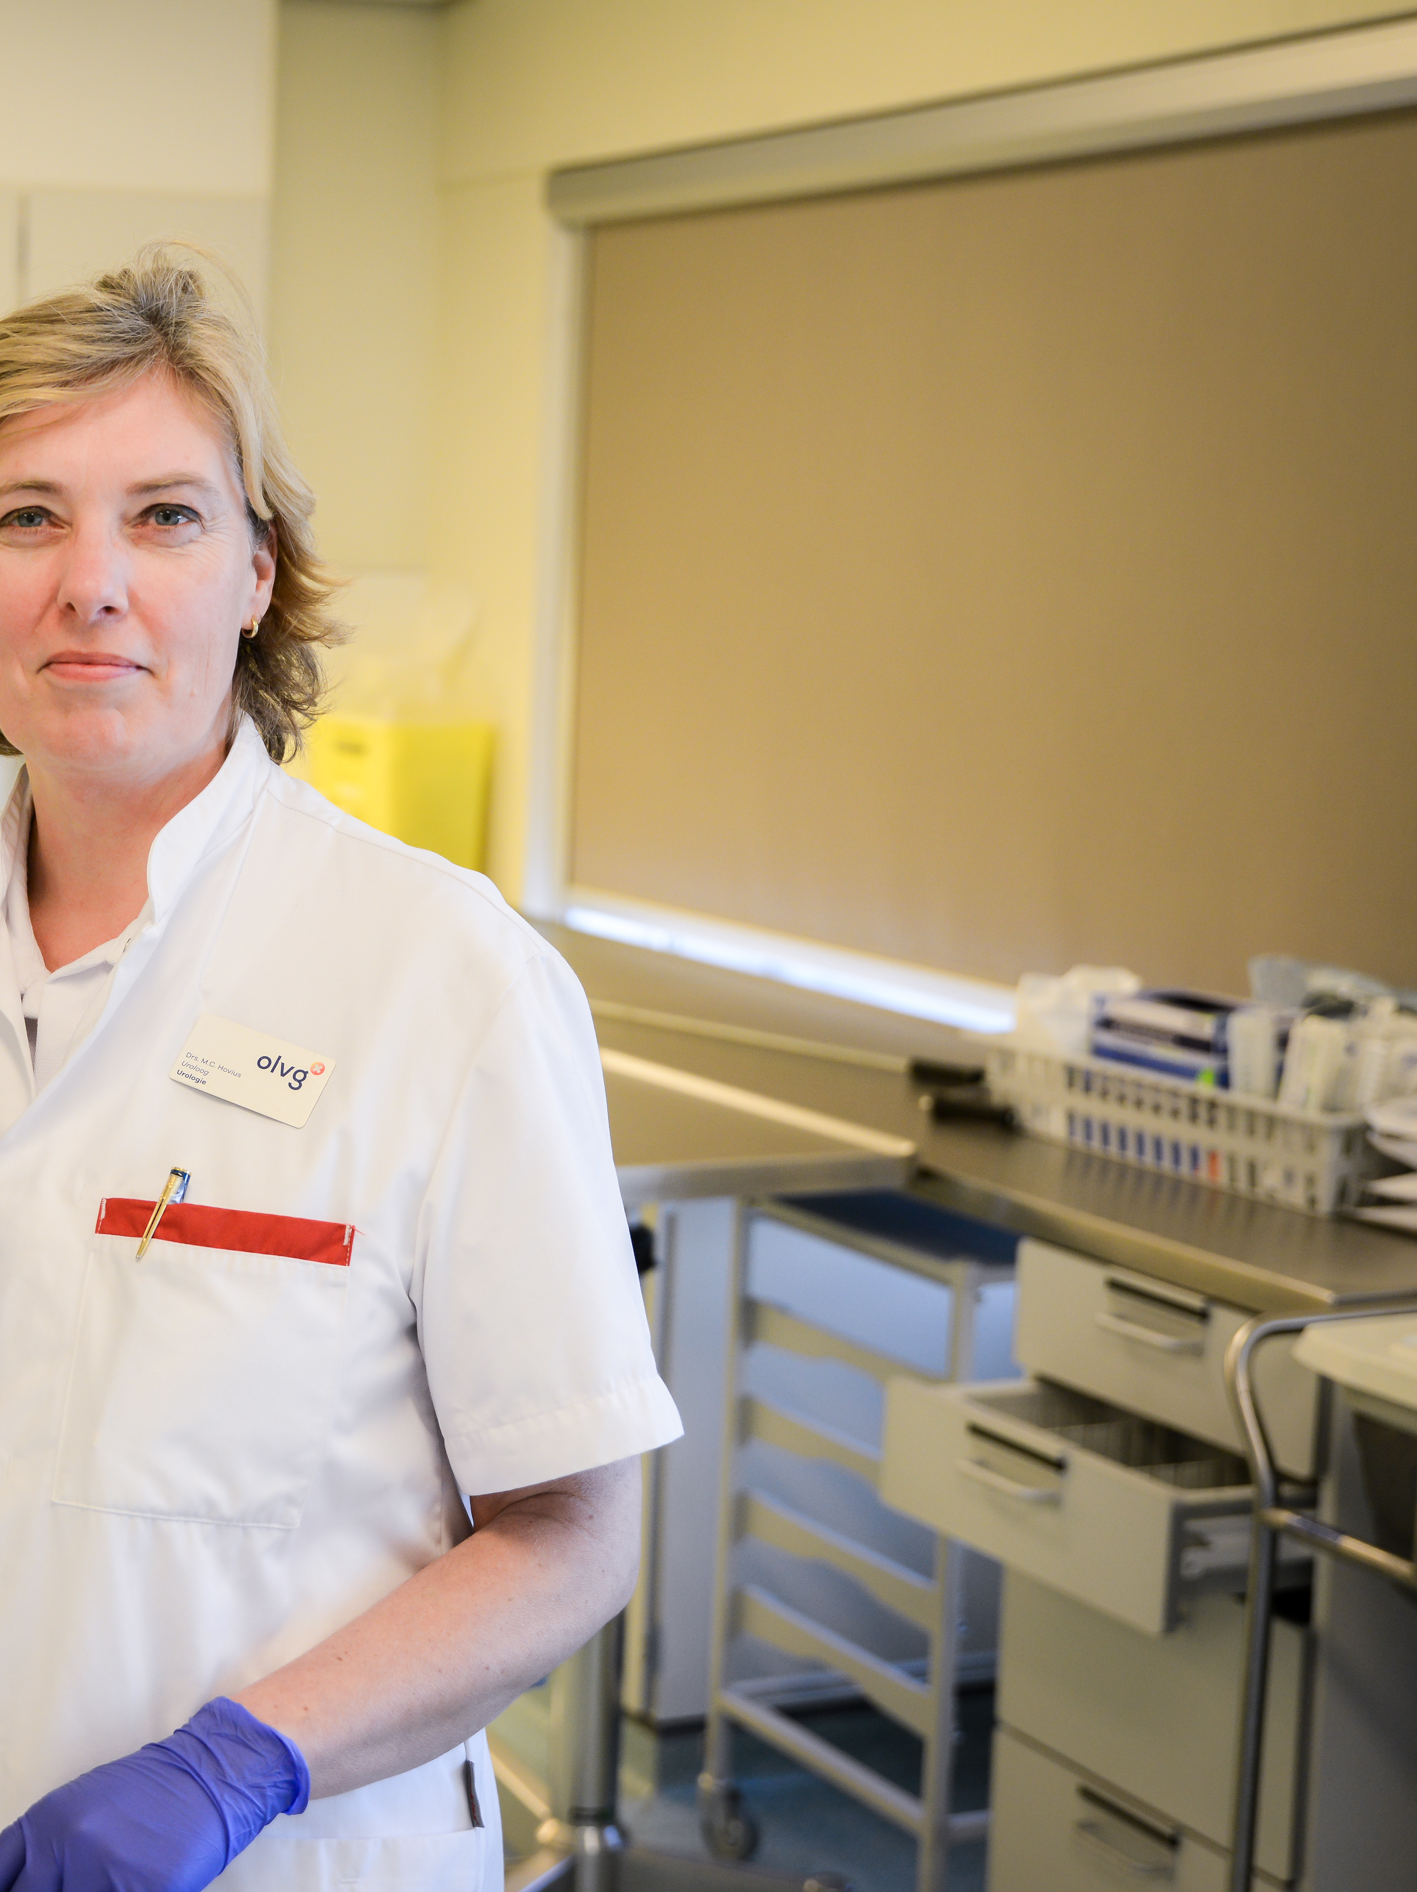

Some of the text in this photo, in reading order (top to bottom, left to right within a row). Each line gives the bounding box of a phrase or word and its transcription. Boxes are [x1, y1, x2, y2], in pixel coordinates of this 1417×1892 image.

[181, 1060, 210, 1077] Uroloog
[185, 1051, 199, 1062] Drs.
[217, 1064, 242, 1079] Hovius
[256, 1055, 309, 1091] olvg
[176, 1069, 207, 1085] Urologie
